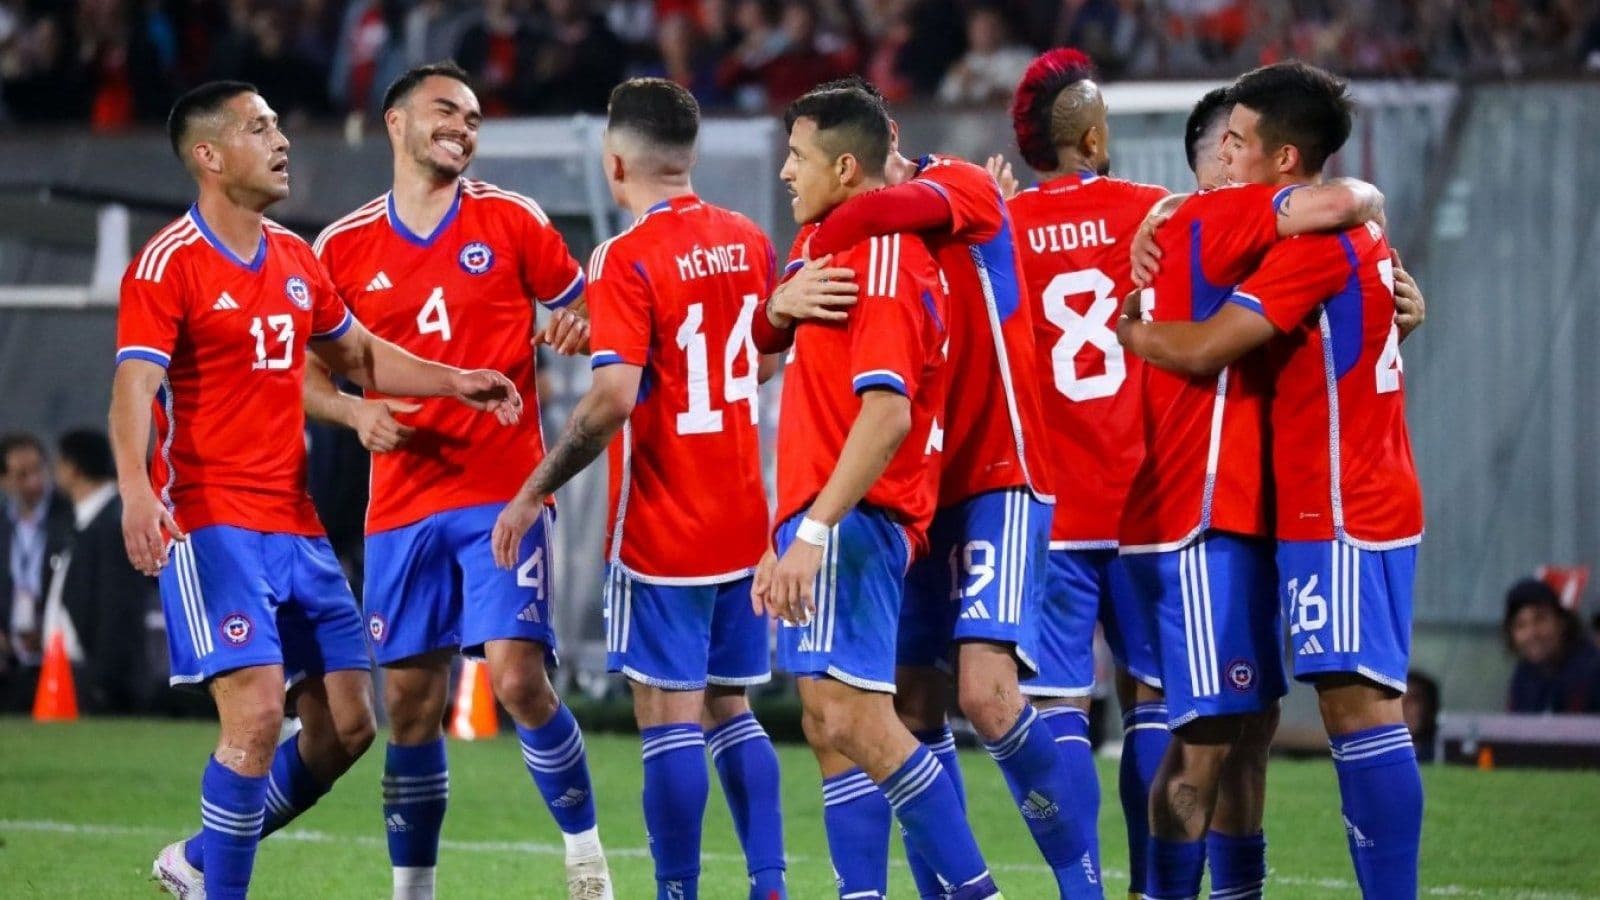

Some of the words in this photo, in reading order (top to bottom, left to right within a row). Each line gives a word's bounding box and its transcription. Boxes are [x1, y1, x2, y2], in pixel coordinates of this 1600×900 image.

[675, 243, 751, 282] MÉNDEZ
[1028, 218, 1117, 254] VIDAL
[247, 313, 295, 371] 13
[416, 286, 452, 341] 4
[1042, 268, 1129, 402] 8
[675, 293, 760, 435] 14
[516, 548, 542, 600] 4
[948, 540, 996, 599] 19
[1287, 574, 1328, 636] 26
